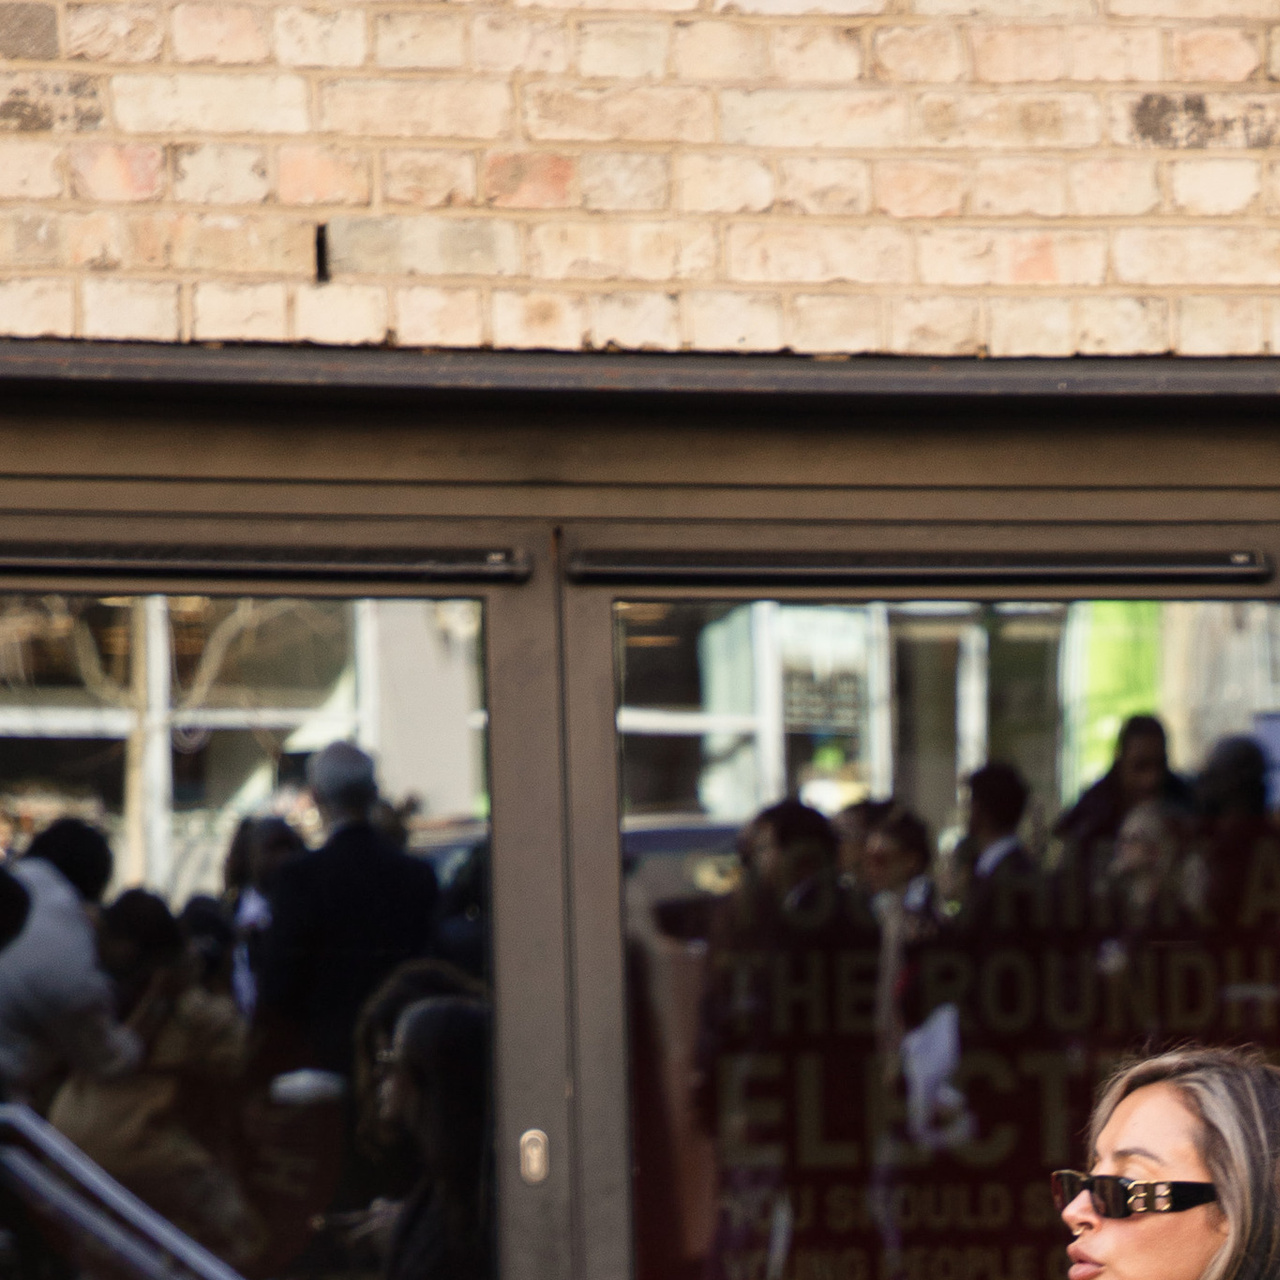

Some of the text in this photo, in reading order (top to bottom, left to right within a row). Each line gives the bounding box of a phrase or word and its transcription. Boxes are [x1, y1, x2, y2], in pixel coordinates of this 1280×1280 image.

[712, 949, 878, 1033] THE
[716, 1050, 1112, 1170] ELECT
[718, 1181, 816, 1231] YOU
[824, 1180, 1014, 1231] SHOULD
